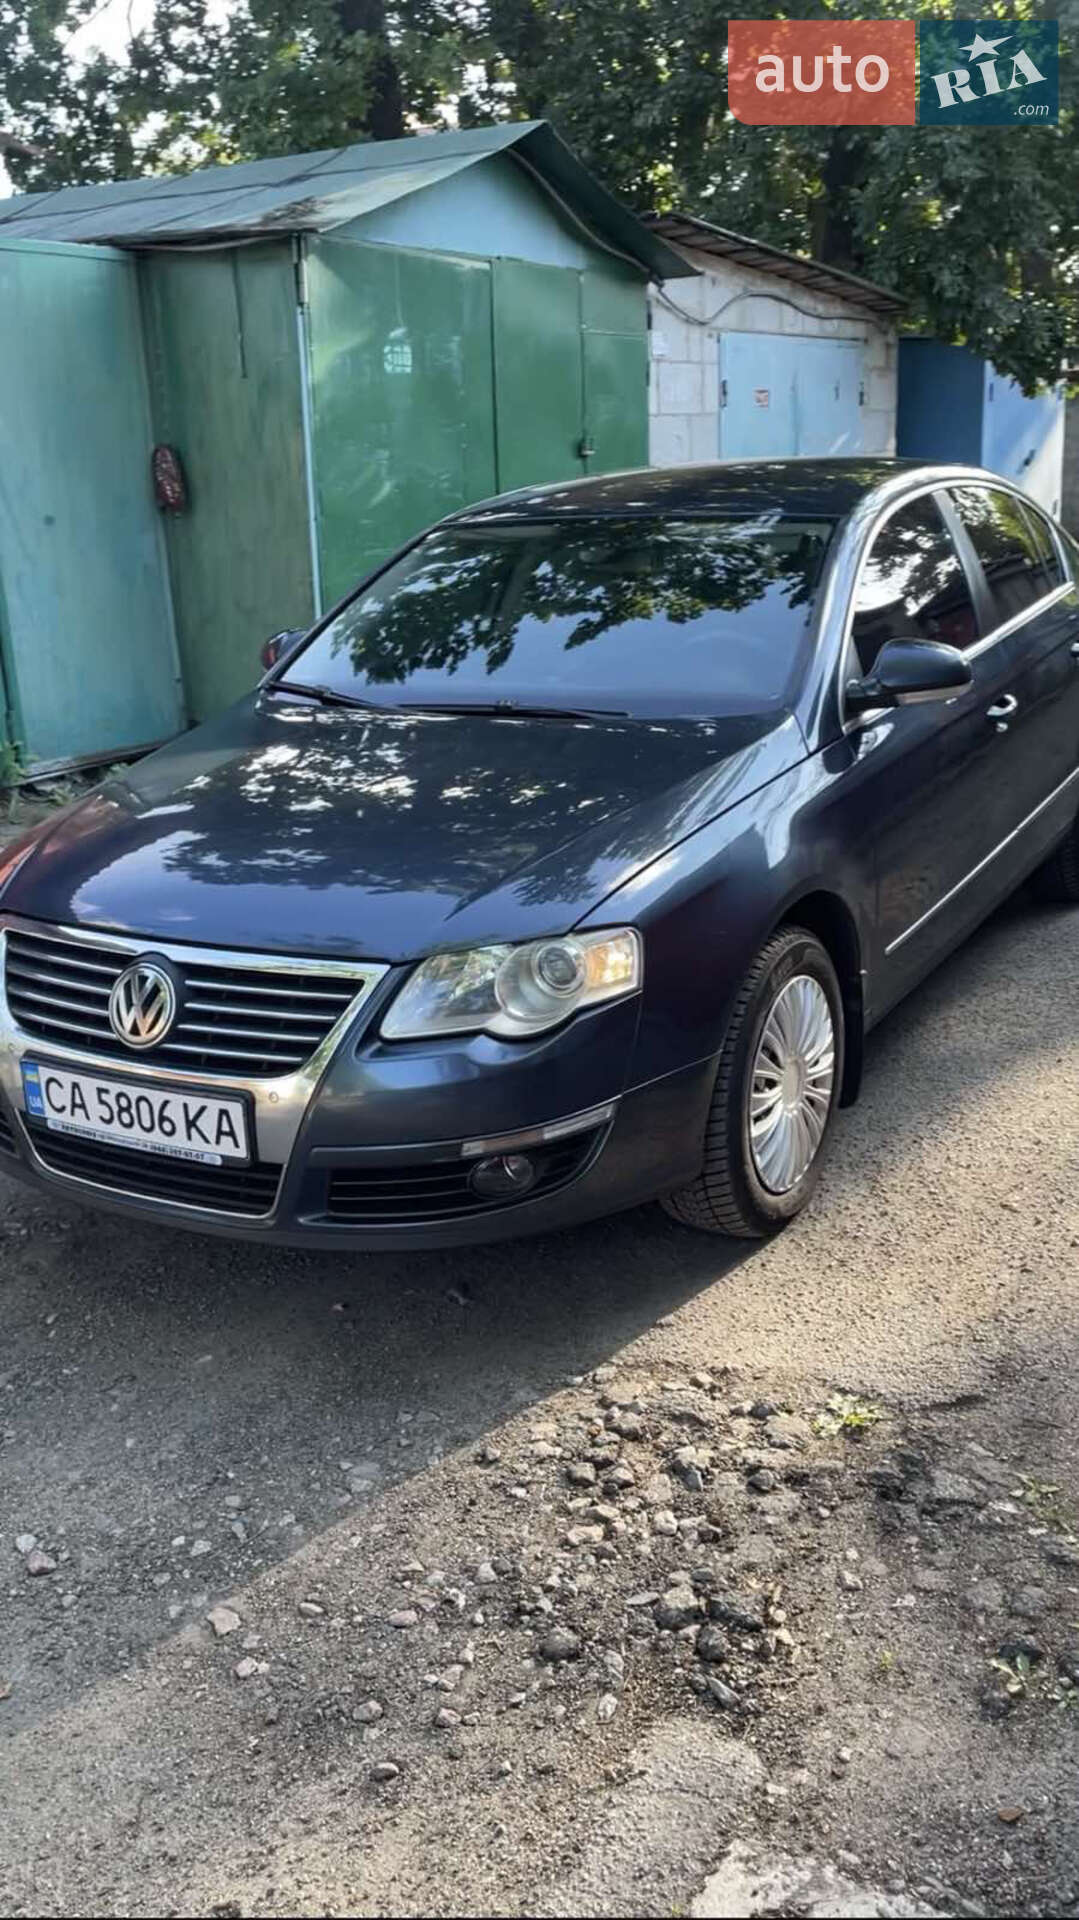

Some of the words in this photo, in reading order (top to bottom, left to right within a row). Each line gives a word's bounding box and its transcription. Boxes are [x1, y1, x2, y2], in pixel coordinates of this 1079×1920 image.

[45, 1076, 91, 1121] CA
[96, 1086, 177, 1138] 5806
[183, 1102, 241, 1149] KA
